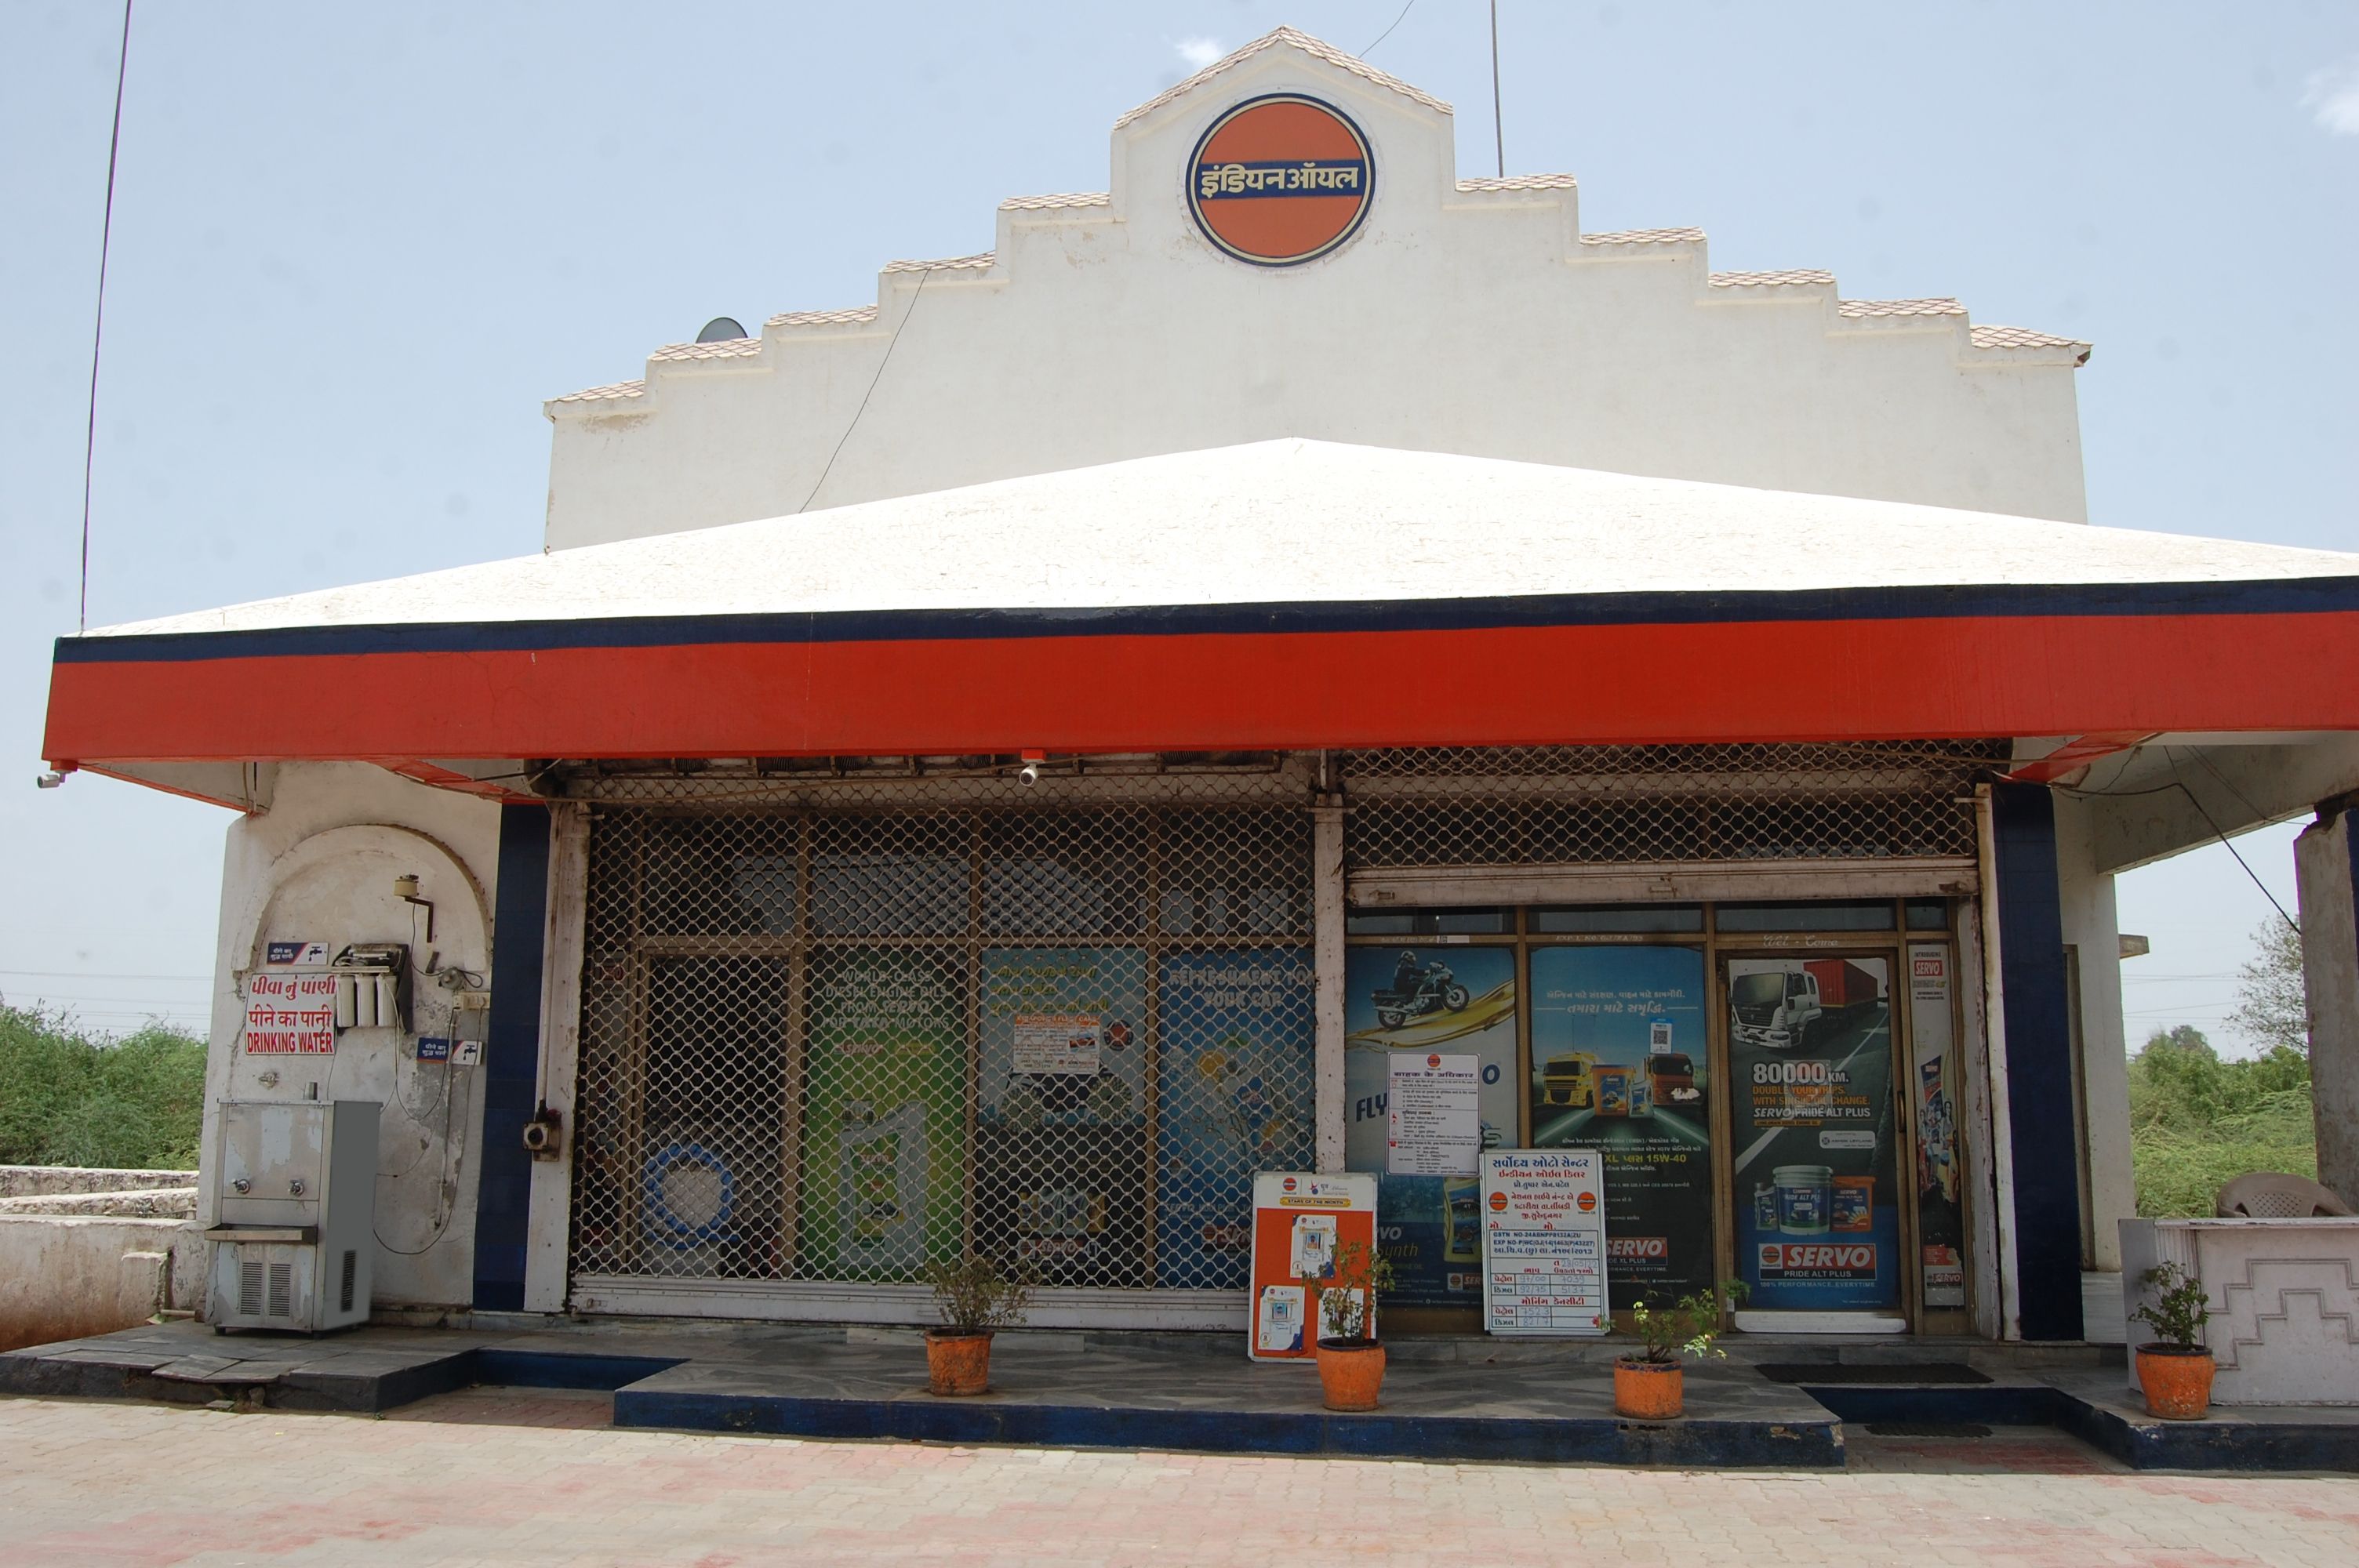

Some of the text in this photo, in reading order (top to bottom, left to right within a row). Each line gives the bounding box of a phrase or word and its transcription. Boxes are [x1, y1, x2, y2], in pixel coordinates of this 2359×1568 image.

[1201, 162, 1359, 198] इंडियनऑयल
[1915, 961, 1940, 975] SERVO
[842, 971, 932, 982] WORLD-CLASS
[252, 975, 282, 995] પીવા
[301, 975, 336, 995] પાણી
[825, 986, 865, 998] DIESEL
[870, 986, 916, 998] ENGINE
[841, 1000, 930, 1014] FROM SERVO
[1567, 1004, 1599, 1013] તમારા
[1604, 1001, 1623, 1013] માટે
[248, 1004, 333, 1028] पीने का पानी
[247, 1032, 333, 1053] DRINKING WATER
[1827, 1072, 1849, 1083] KM.
[1752, 1085, 1845, 1094] DOUBLE YOUR TRIPS.
[1752, 1096, 1776, 1105] WITH
[1779, 1096, 1812, 1105] SINGLE
[1832, 1096, 1870, 1105] CHANGE.
[1754, 1108, 1870, 1118] SERVO PRIDE ALT PLUS
[1492, 1156, 1589, 1168] સર્વોદય ઓટો સેન્ટર
[1605, 1154, 1619, 1163] XL
[1647, 1153, 1687, 1163] 15W-40
[1606, 1240, 1663, 1256] SERVO
[1787, 1246, 1871, 1268] SERVO
[1463, 1276, 1481, 1285] SER
